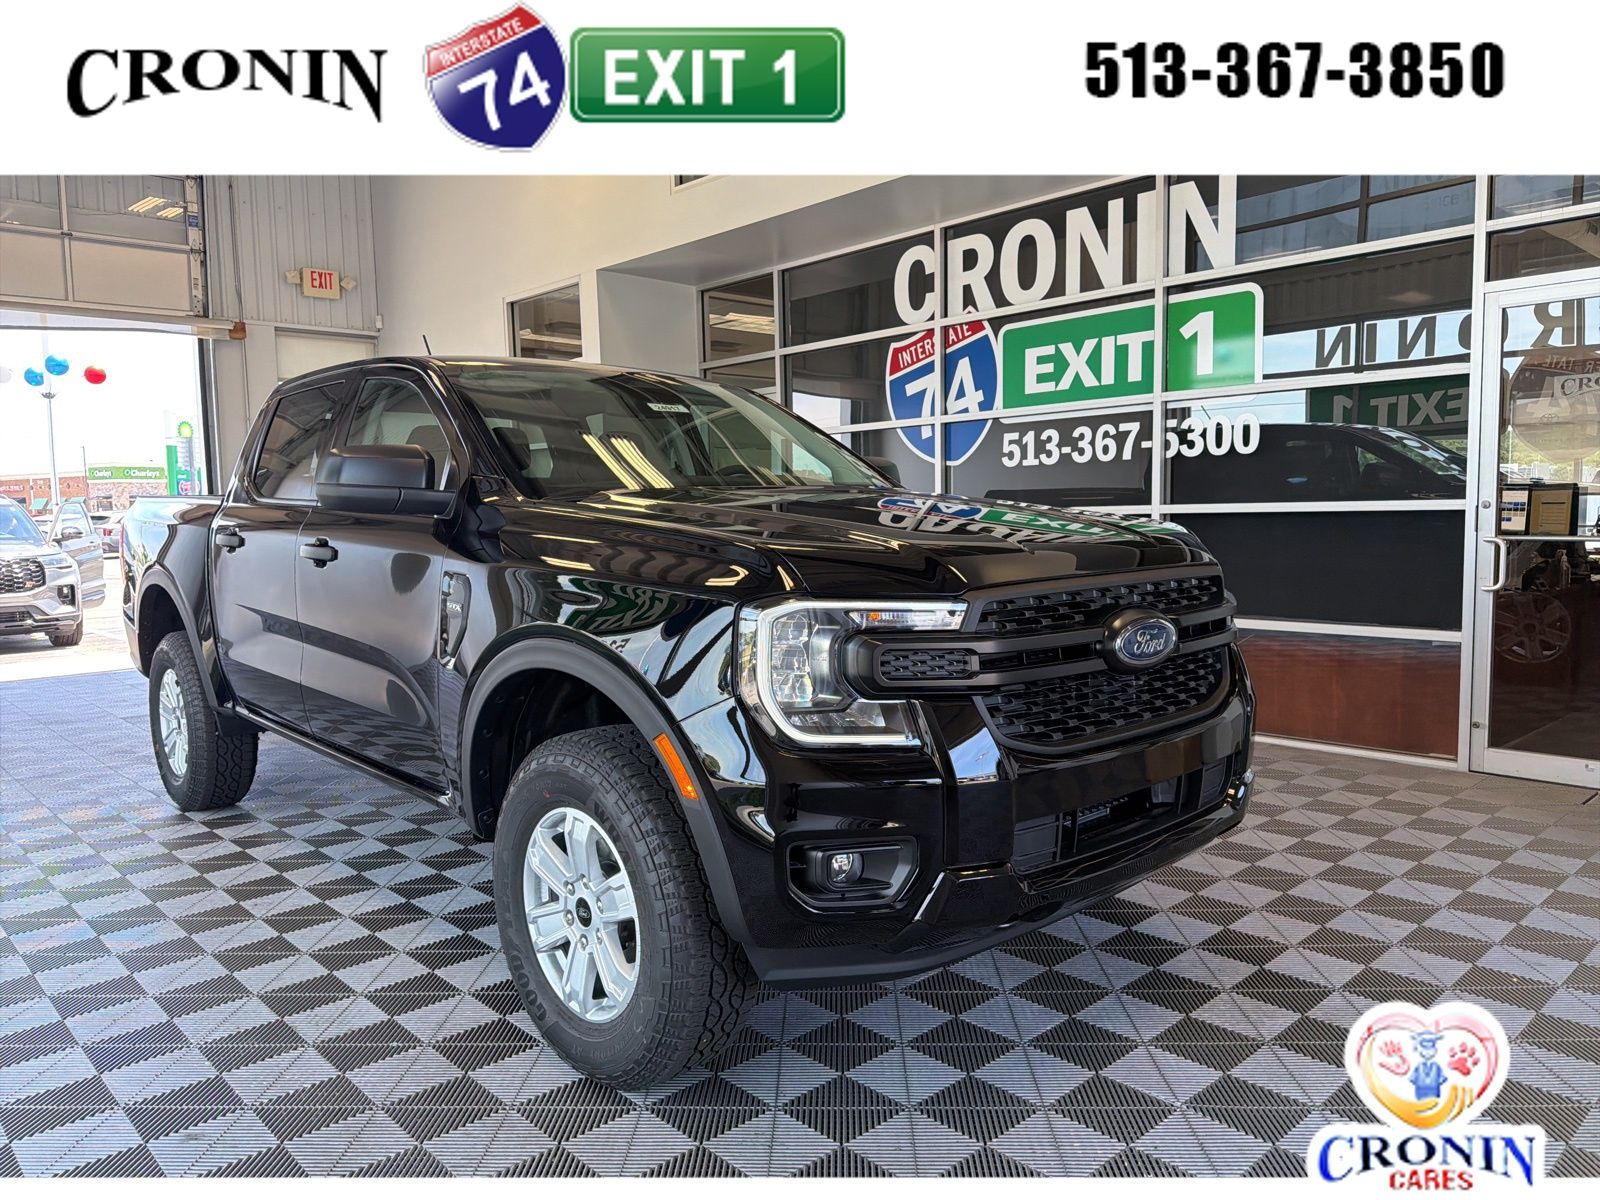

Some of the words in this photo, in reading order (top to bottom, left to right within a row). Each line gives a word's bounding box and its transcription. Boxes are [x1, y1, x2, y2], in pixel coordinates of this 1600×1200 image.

[894, 174, 1237, 325] CRONIN
[310, 270, 333, 290] EXIT
[898, 322, 971, 369] INTERATE
[1025, 330, 1154, 395] EXIT
[1179, 310, 1214, 376] 1
[904, 356, 984, 440] 74
[1001, 413, 1260, 467] 513-367-5300
[1134, 629, 1166, 655] Ford
